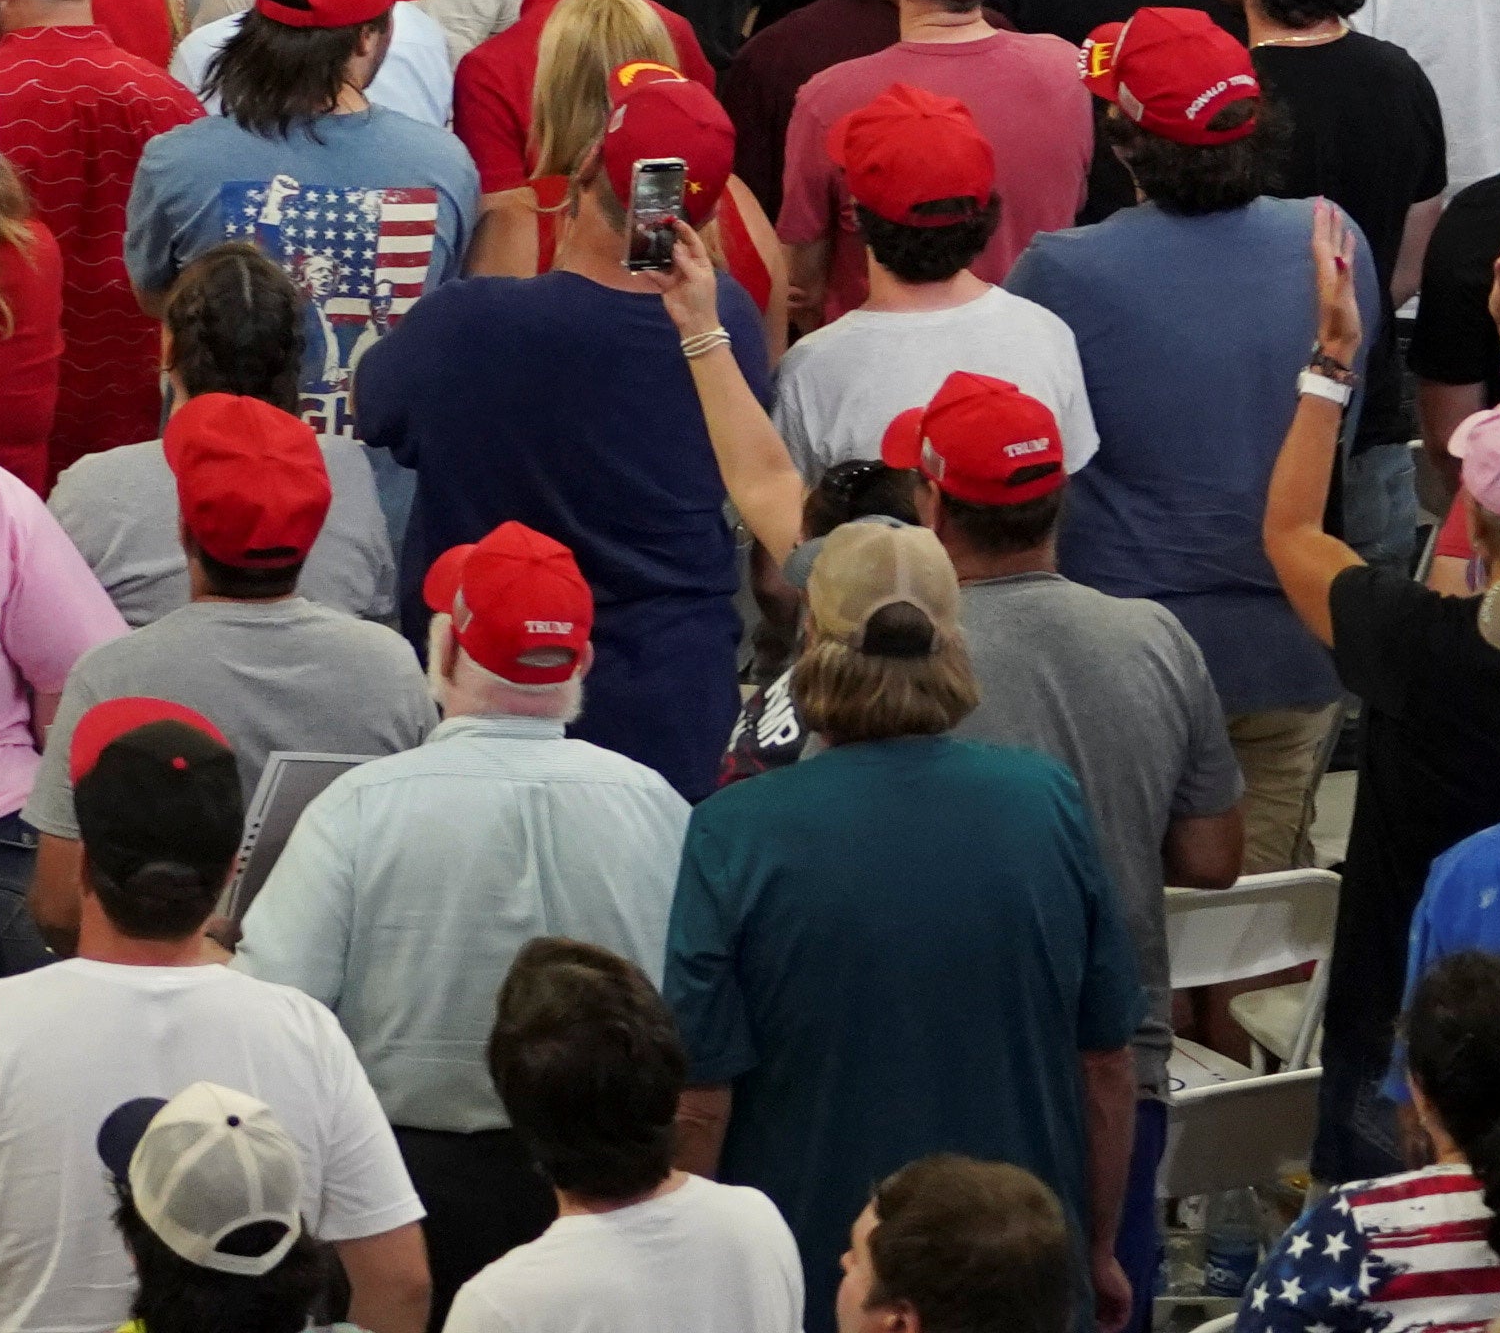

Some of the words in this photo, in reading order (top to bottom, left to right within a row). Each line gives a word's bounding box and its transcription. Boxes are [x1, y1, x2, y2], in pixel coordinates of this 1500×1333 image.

[1185, 81, 1227, 120] DONALD
[1004, 439, 1049, 457] TRUMP
[524, 621, 573, 634] TRUMP
